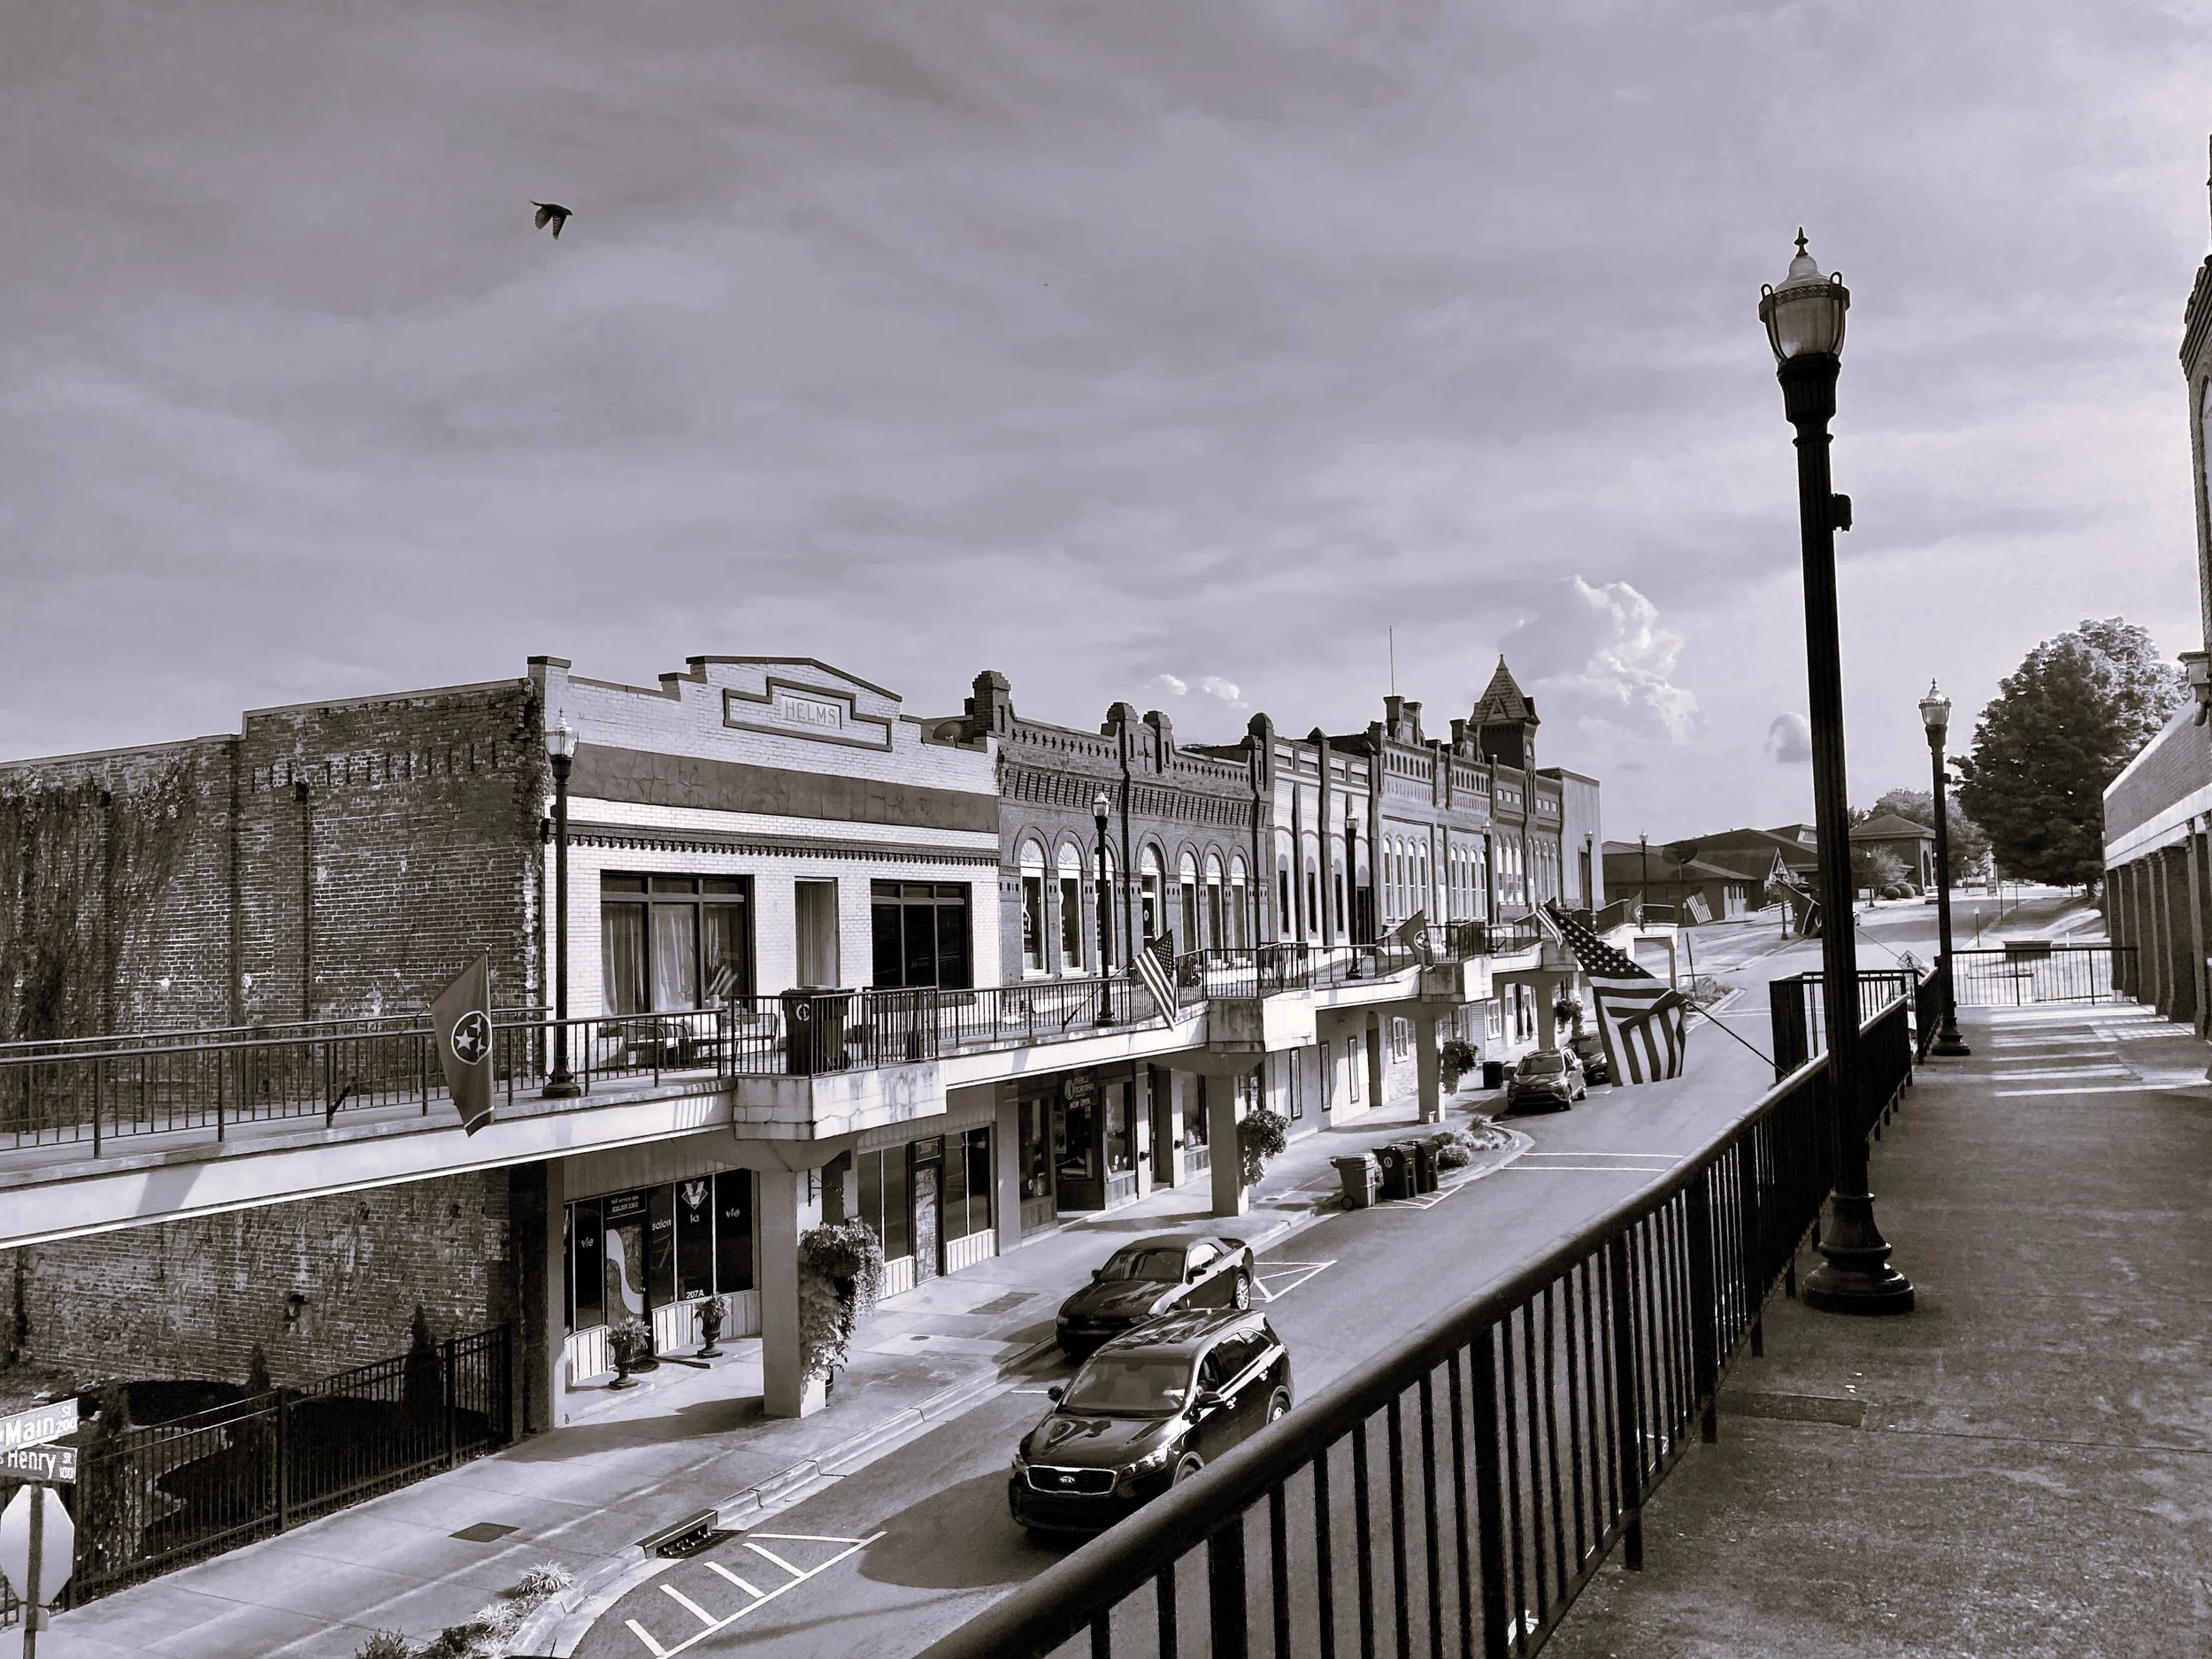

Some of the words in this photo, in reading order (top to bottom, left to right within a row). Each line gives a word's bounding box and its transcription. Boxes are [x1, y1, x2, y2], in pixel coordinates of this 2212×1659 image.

[785, 700, 836, 725] HELMS
[651, 1218, 672, 1231] salon
[726, 1207, 741, 1217] vie
[581, 1237, 594, 1248] vie
[686, 1289, 705, 1300] 207A
[5, 1414, 53, 1447] Main
[56, 1417, 78, 1433] 200
[8, 1450, 56, 1479] Henry
